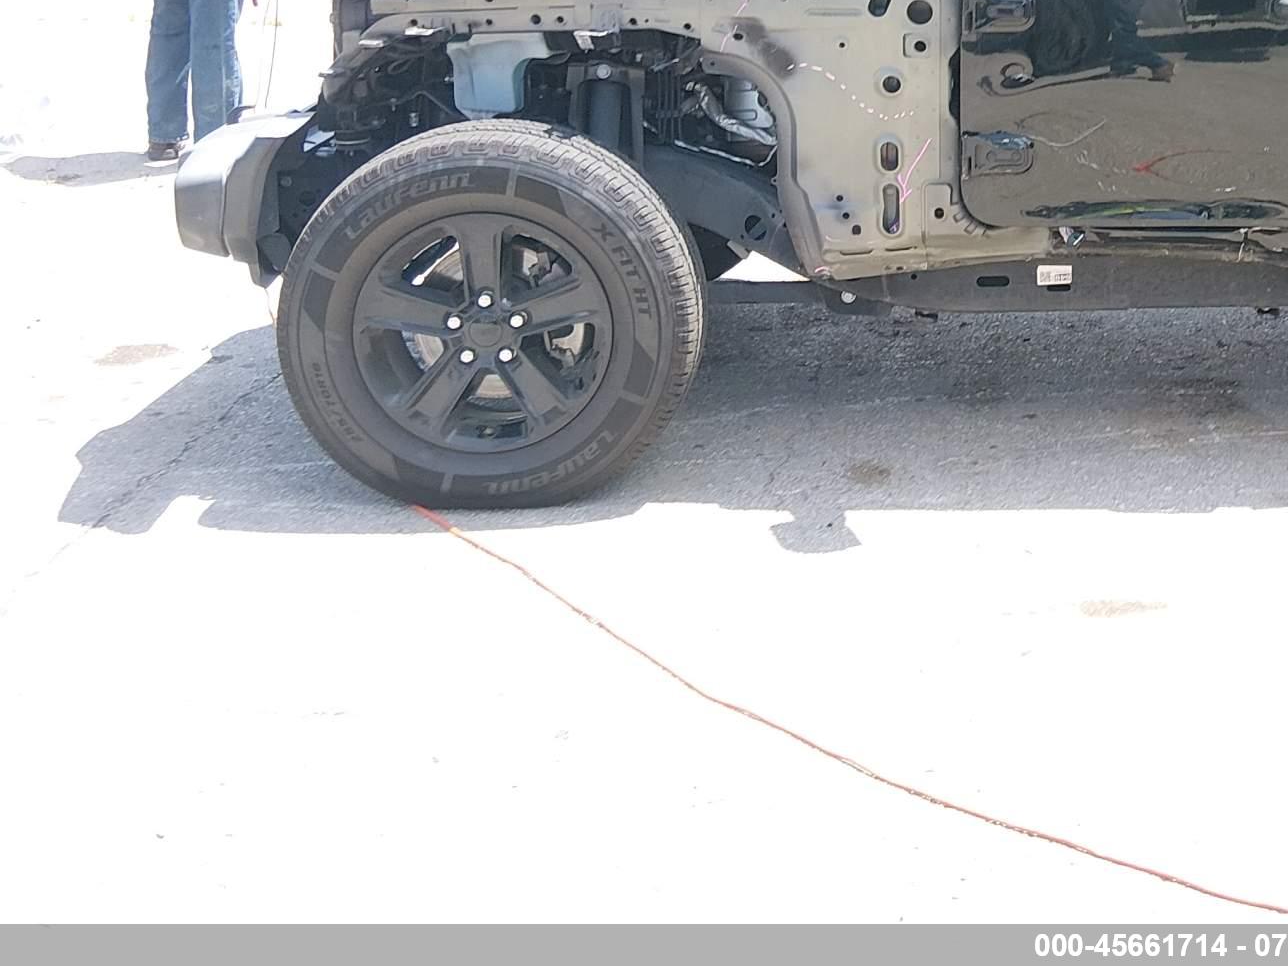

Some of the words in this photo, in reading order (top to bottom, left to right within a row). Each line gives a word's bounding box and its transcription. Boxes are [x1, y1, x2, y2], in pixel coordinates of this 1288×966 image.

[344, 173, 473, 239] Laufenn
[591, 222, 616, 243] X
[611, 246, 641, 280] FIT
[632, 287, 652, 321] HT
[487, 430, 617, 495] Laufenn
